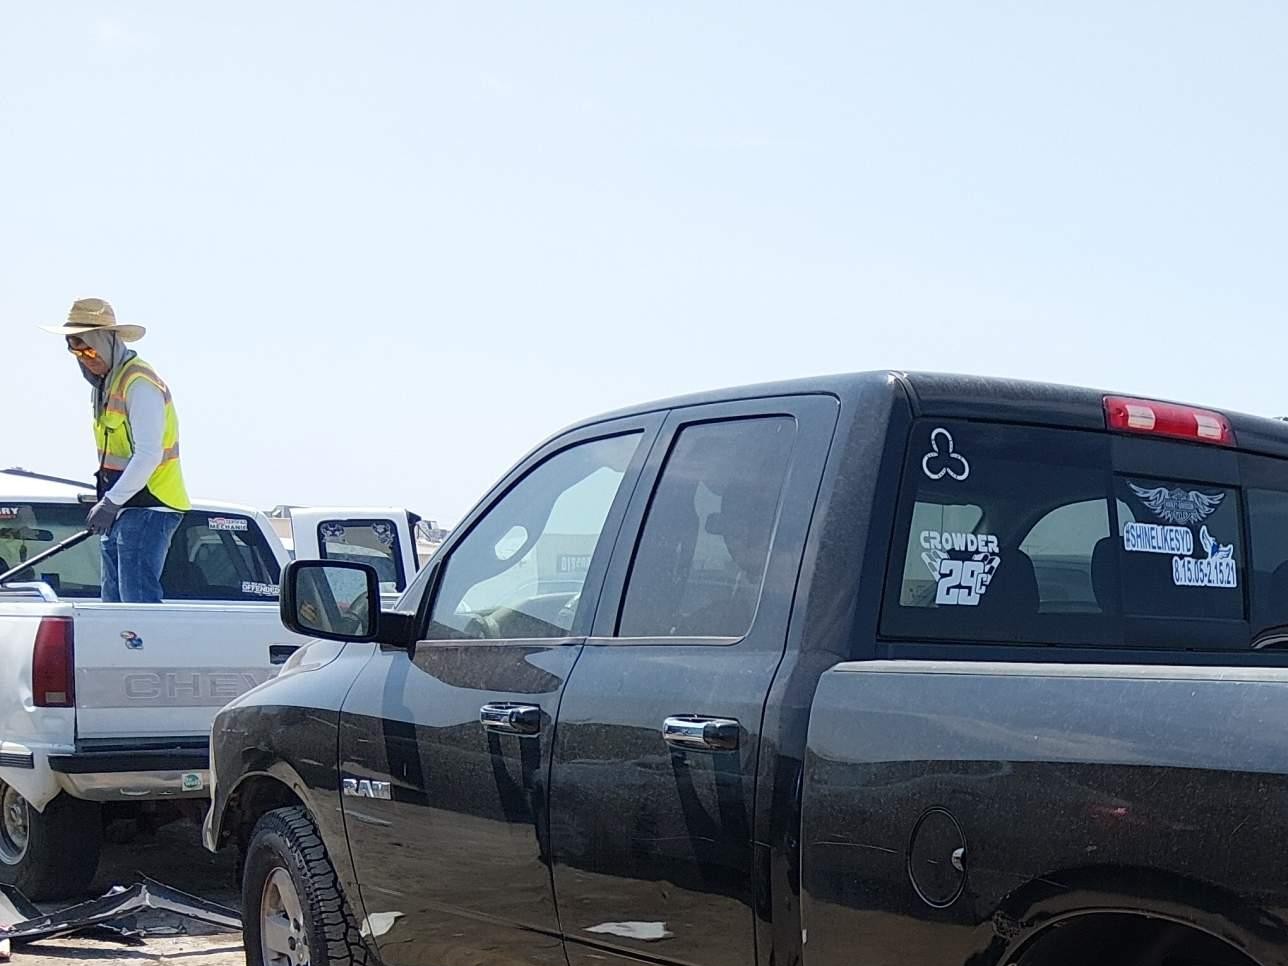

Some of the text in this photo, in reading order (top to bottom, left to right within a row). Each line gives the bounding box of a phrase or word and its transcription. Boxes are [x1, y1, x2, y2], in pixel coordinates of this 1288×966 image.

[920, 531, 999, 553] CROWDER
[1125, 524, 1192, 554] #SHINELIKESYD
[1174, 560, 1236, 586] 8.15.05-2.15.21
[343, 778, 391, 799] RAM
